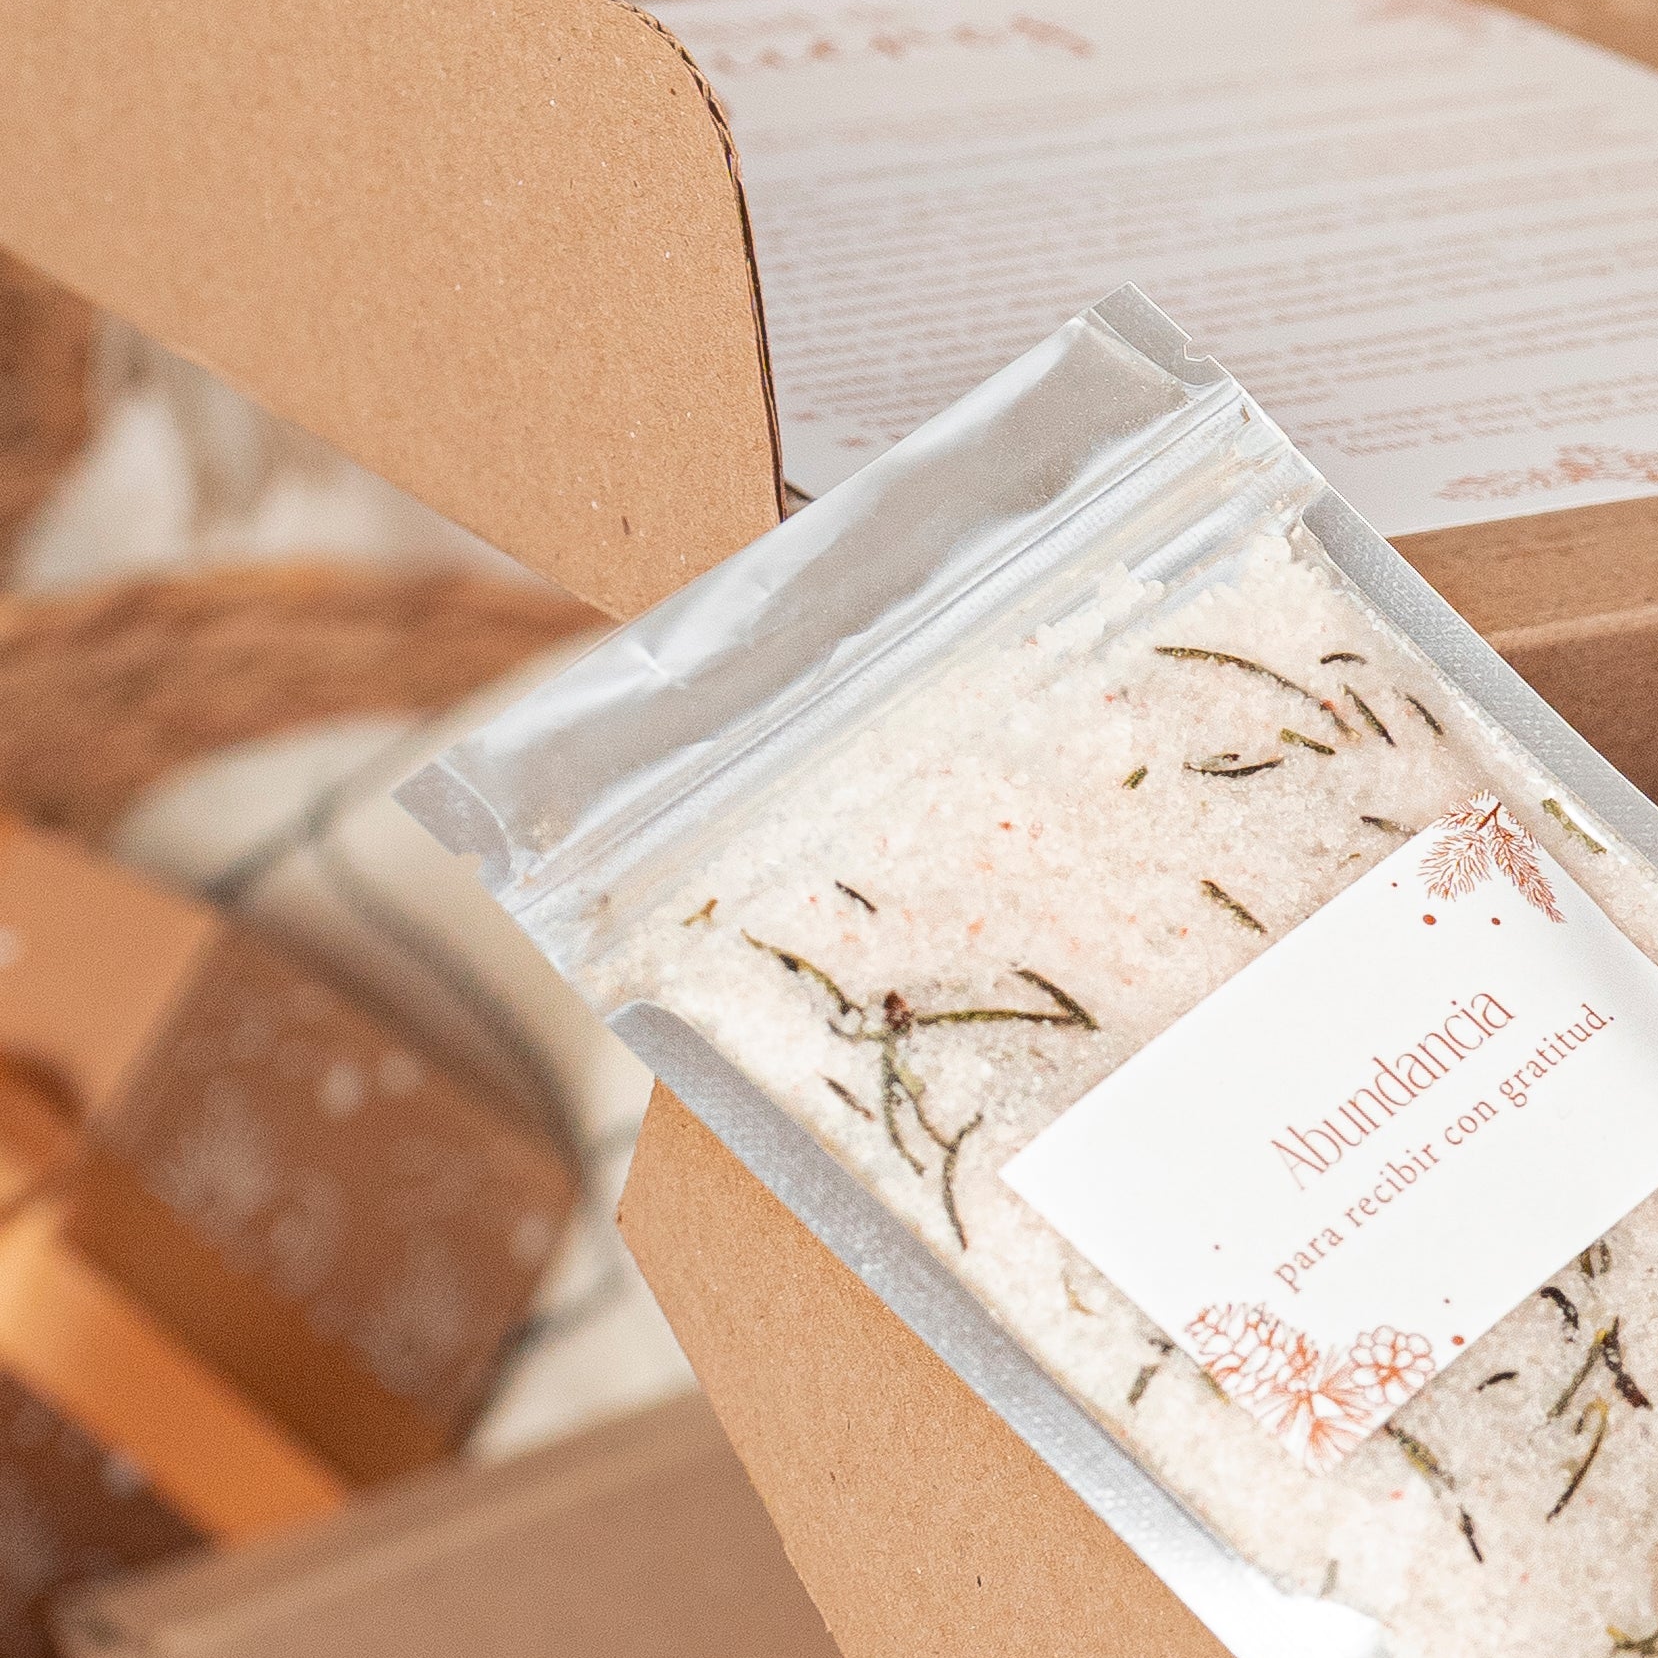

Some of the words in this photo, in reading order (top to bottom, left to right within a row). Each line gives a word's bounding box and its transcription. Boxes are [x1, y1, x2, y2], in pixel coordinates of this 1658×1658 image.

[1271, 992, 1515, 1191] Abundancia
[1274, 1227, 1344, 1294] para
[1344, 1144, 1440, 1228] recibir
[1444, 1099, 1499, 1146] con
[1499, 1002, 1615, 1109] gratitud.
